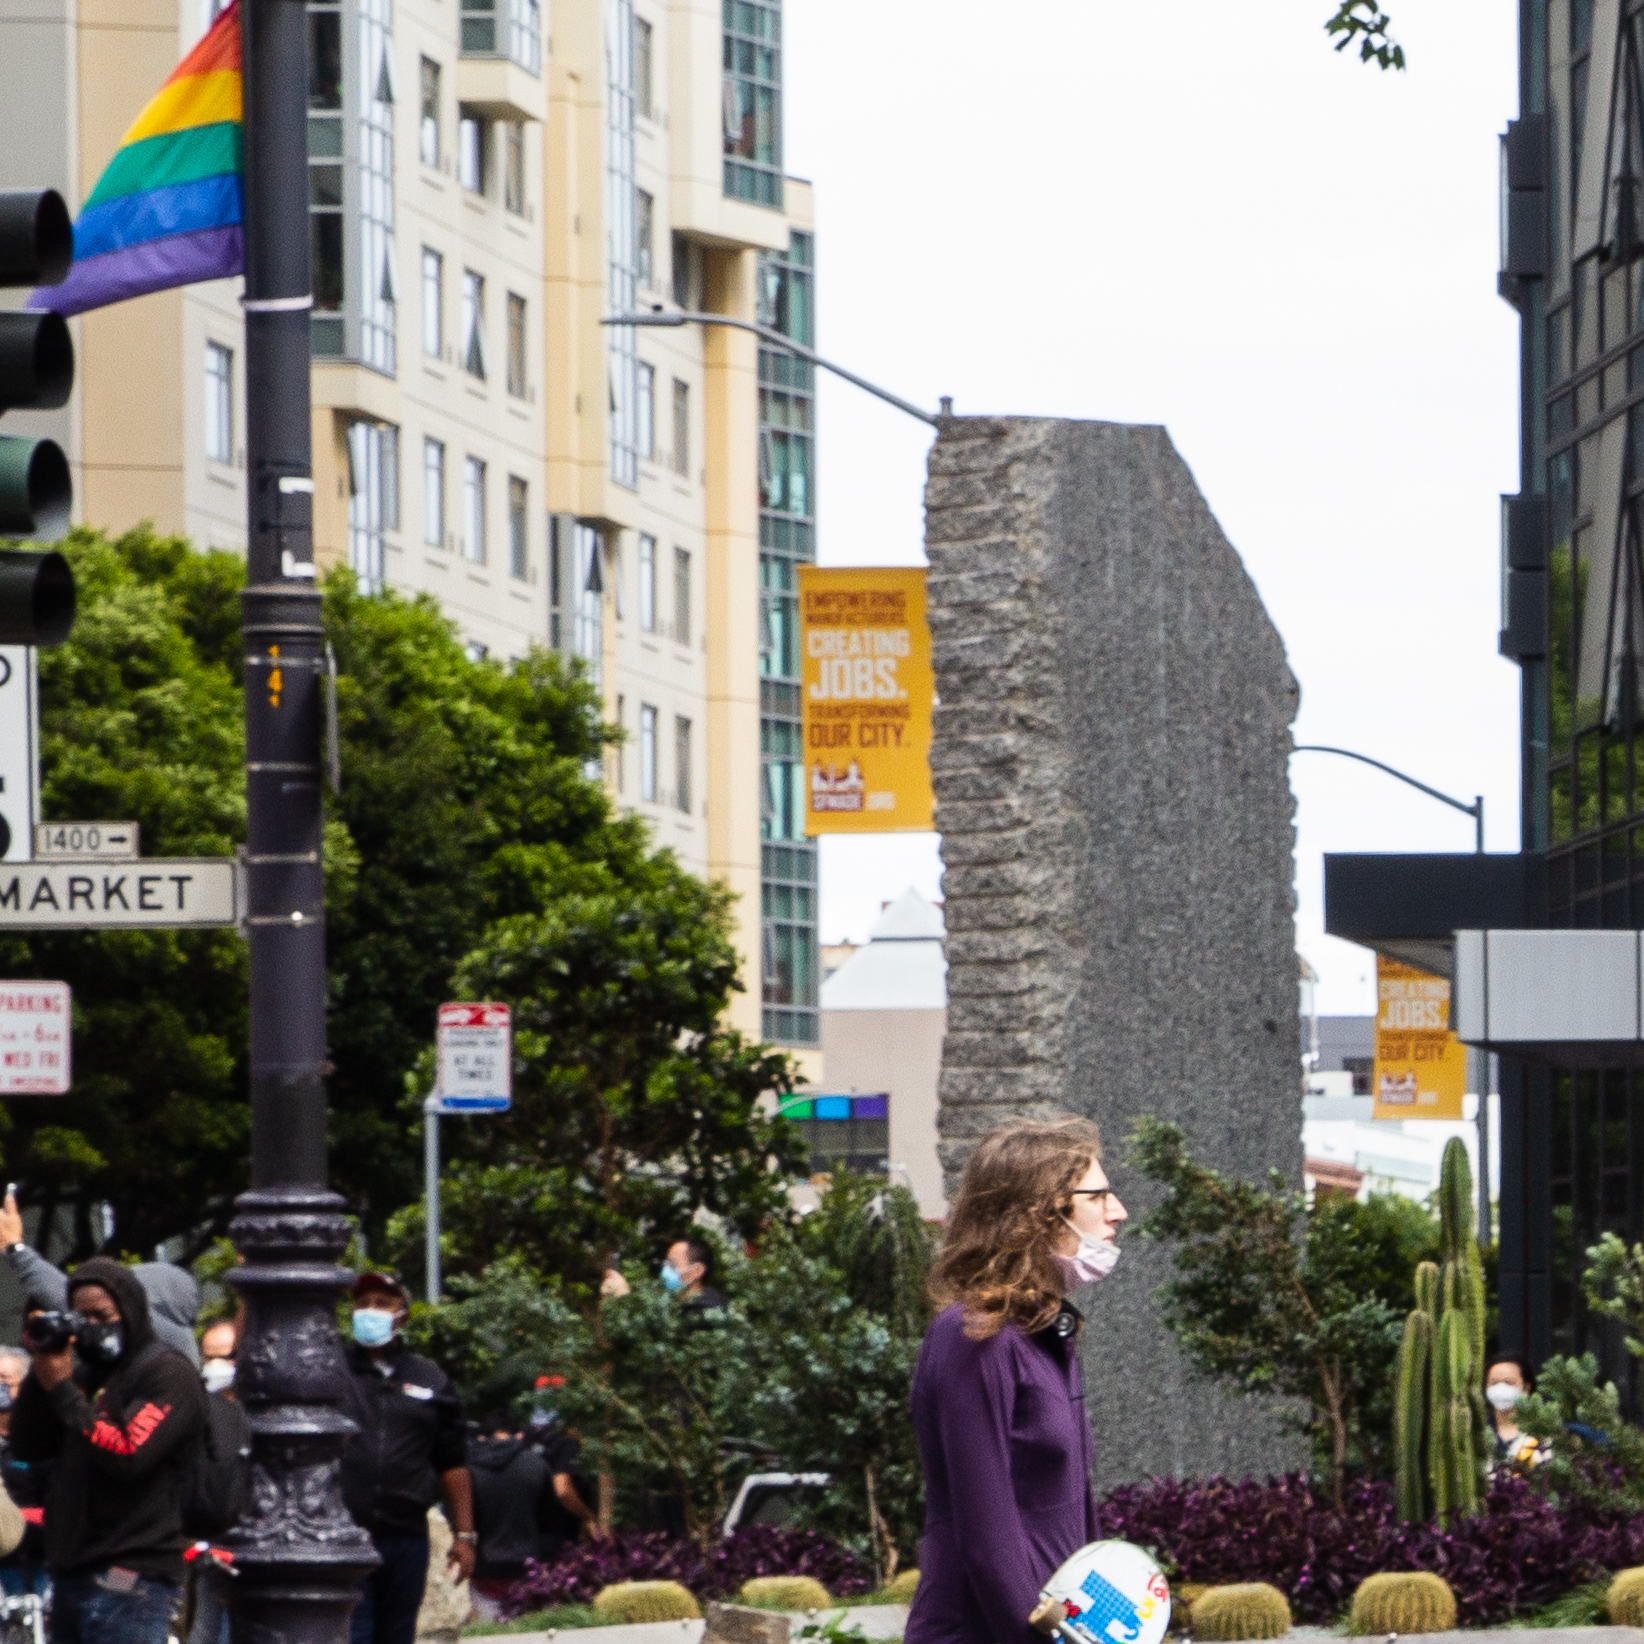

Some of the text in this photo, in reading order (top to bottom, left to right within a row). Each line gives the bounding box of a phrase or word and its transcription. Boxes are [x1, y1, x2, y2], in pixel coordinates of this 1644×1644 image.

[808, 629, 909, 657] CREATING
[810, 659, 907, 698] JOBS.
[810, 723, 851, 748] OUR
[45, 827, 101, 850] 1400
